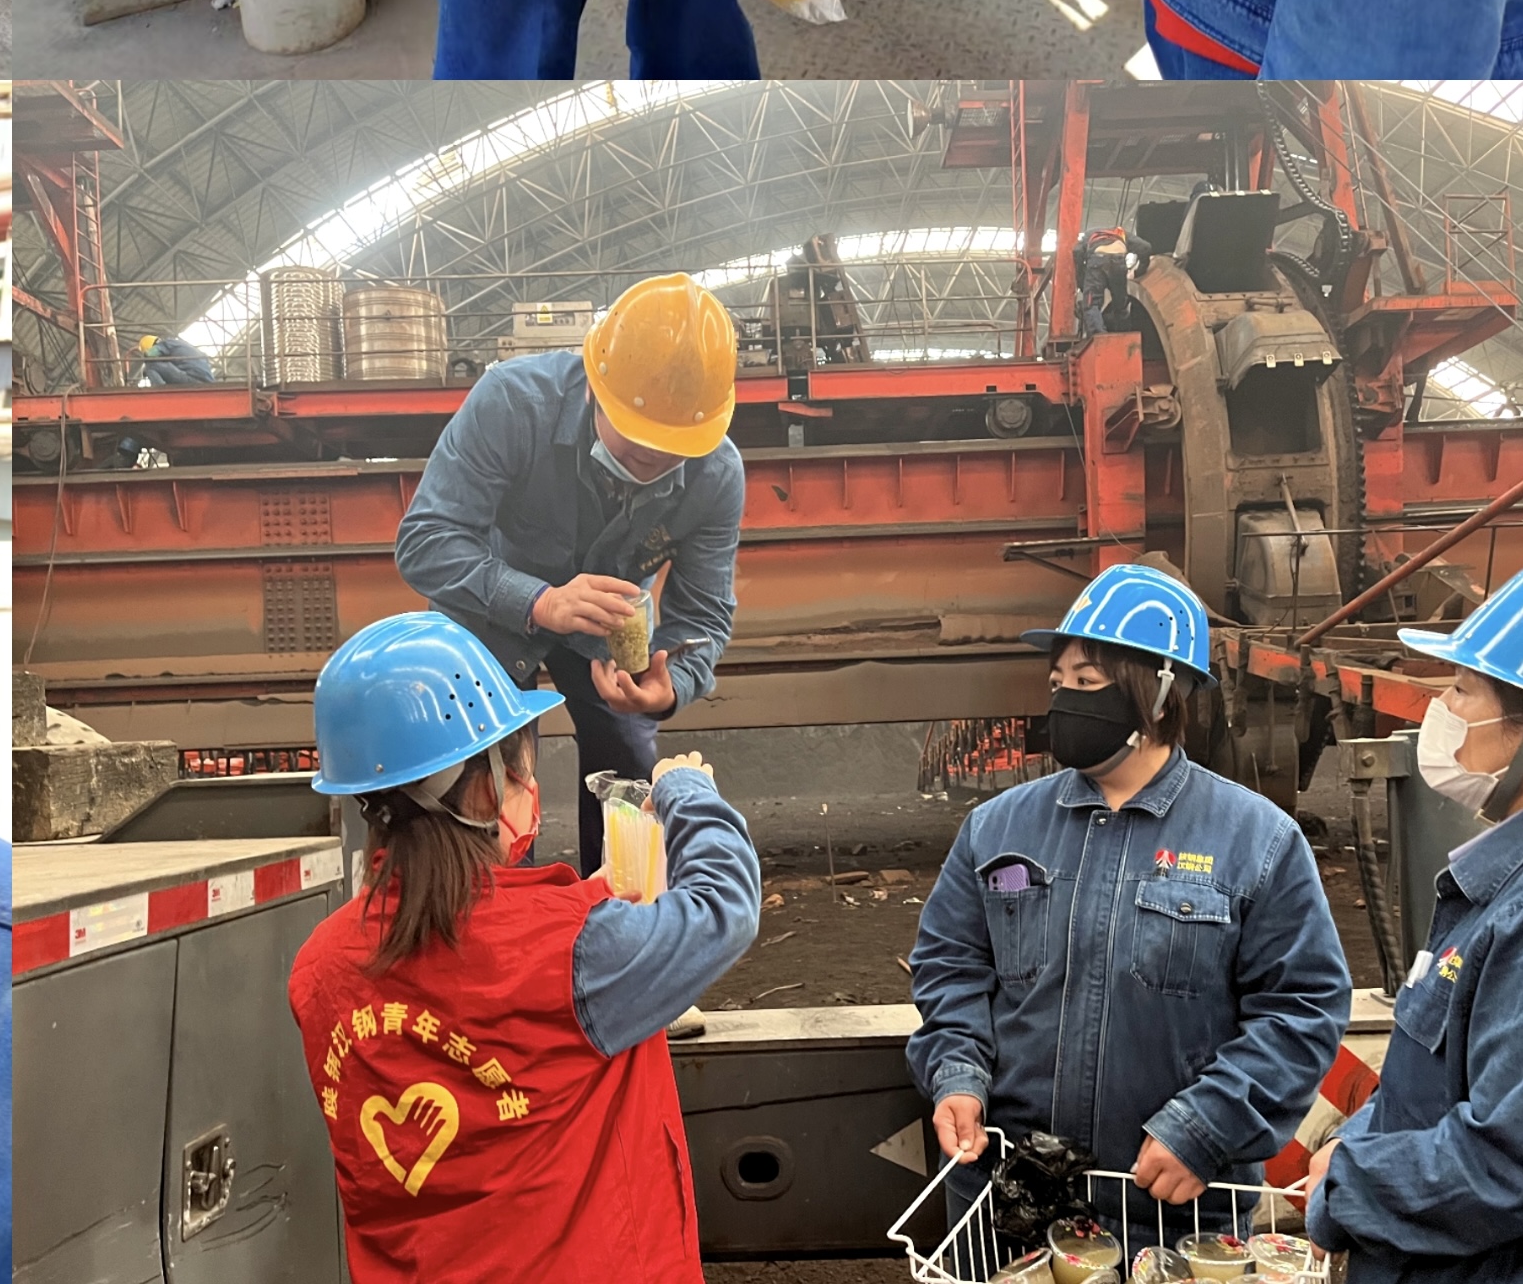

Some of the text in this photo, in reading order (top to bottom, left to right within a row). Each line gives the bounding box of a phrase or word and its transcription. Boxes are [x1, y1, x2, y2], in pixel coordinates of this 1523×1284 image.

[75, 927, 86, 939] 3M
[321, 1001, 530, 1121] 陕钢汉钢青年志愿者
